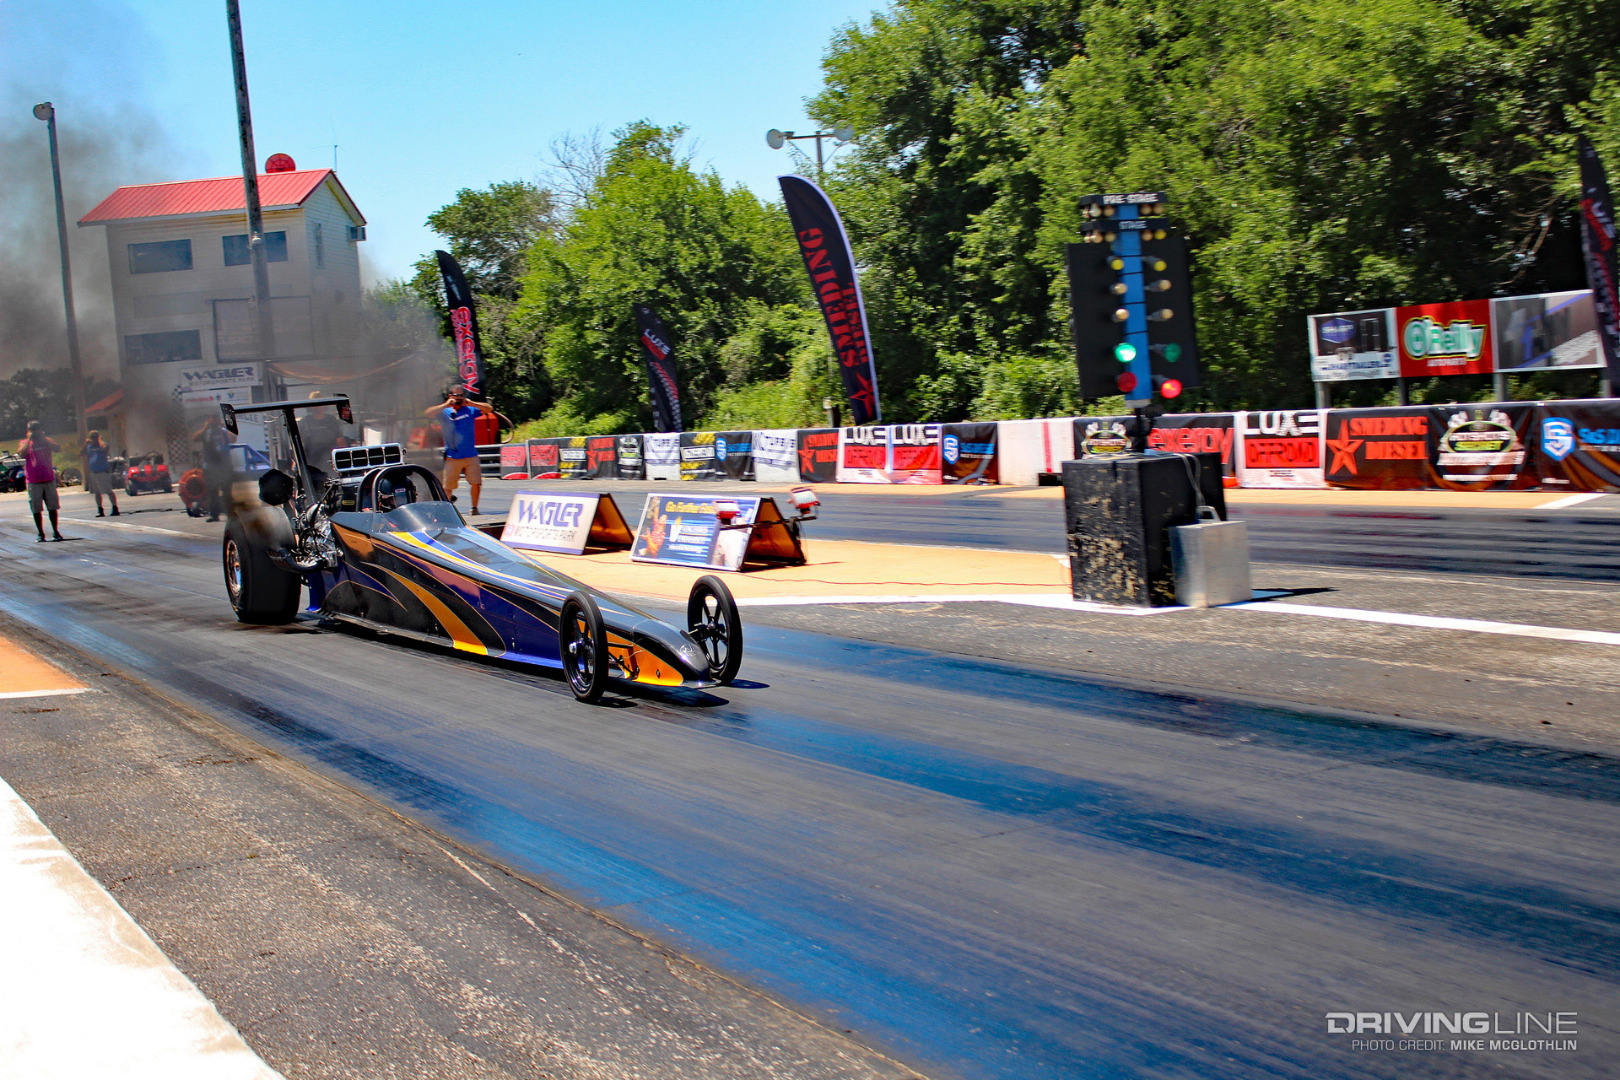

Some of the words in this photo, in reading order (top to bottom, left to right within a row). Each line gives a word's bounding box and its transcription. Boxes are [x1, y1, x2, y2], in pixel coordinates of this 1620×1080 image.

[457, 306, 480, 394] exergy
[182, 366, 254, 382] WAGLER
[1242, 412, 1319, 436] LUXE
[518, 499, 584, 528] WAGLER
